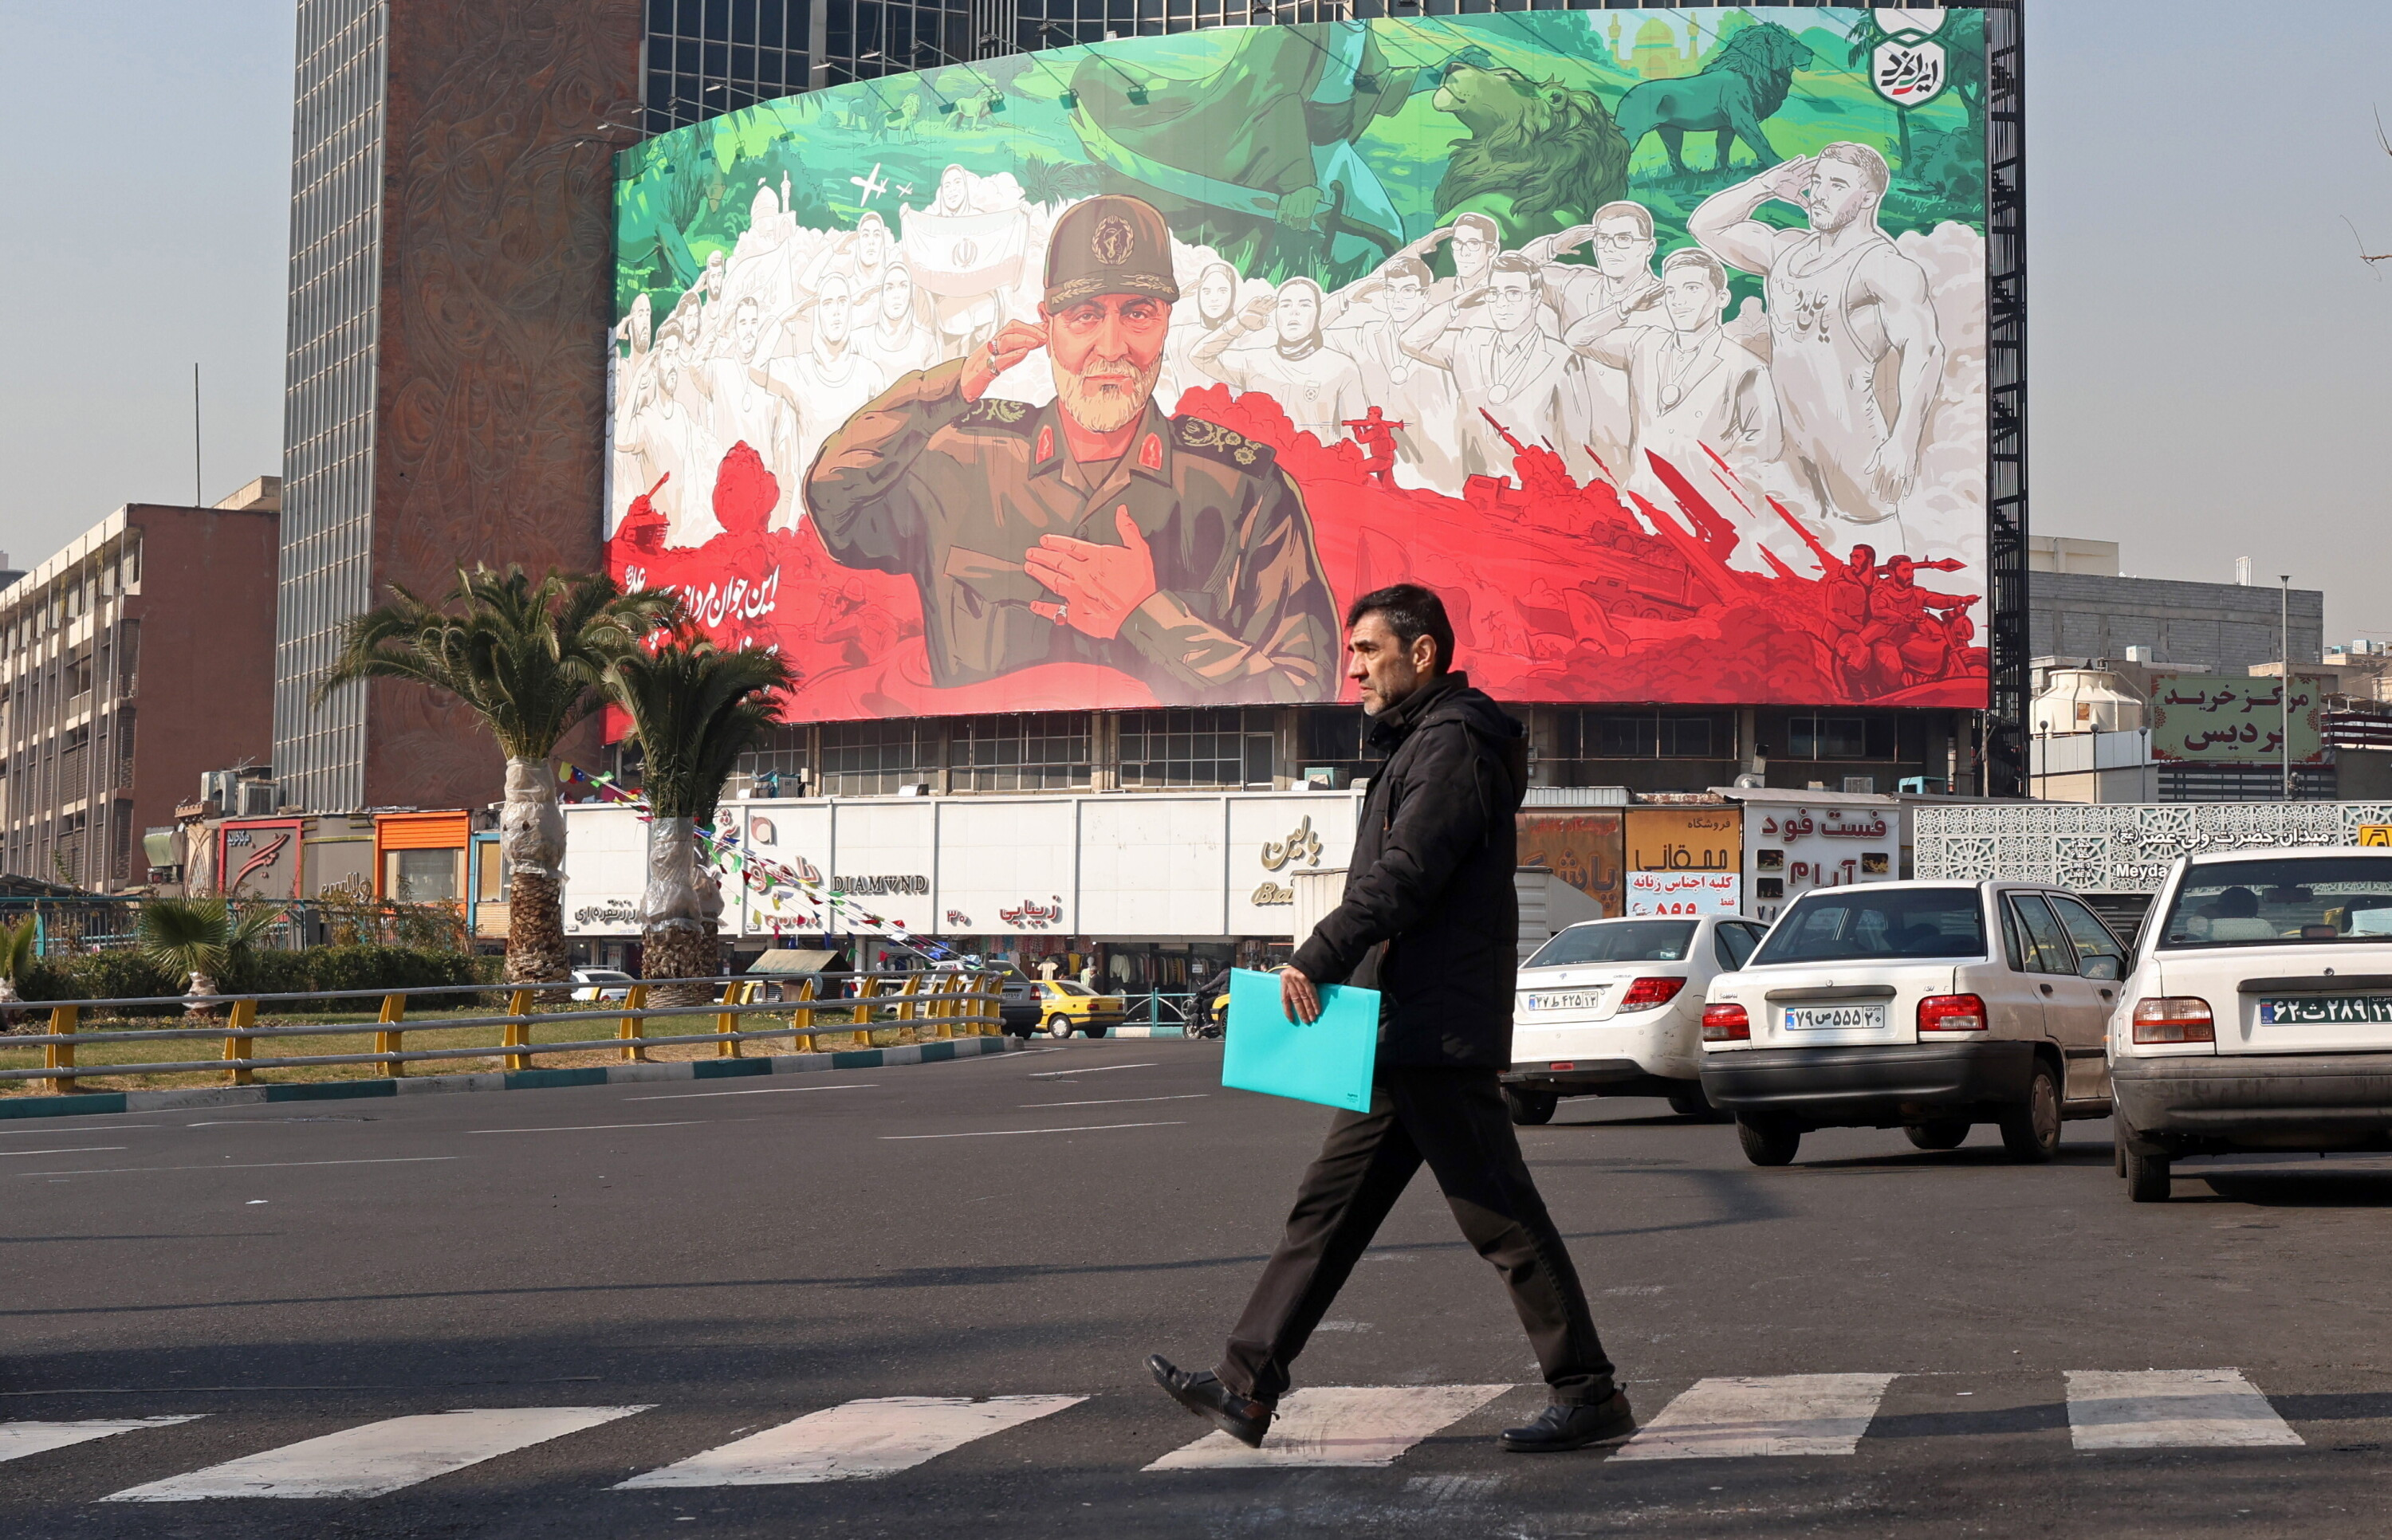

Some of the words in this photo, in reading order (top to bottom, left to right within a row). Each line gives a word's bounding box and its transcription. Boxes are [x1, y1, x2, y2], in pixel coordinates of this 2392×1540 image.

[745, 564, 780, 619] این
[2164, 684, 2237, 713] خرید
[2241, 683, 2309, 713] مرکز
[1687, 818, 1731, 831] فروشگاه
[1760, 807, 1815, 843] فود
[1820, 808, 1888, 838] فست
[1261, 814, 1320, 870] بالین
[2138, 831, 2177, 848] عصر
[2181, 827, 2210, 849] ولی
[2214, 827, 2274, 847] حضرت
[2280, 827, 2329, 847] میدان
[1633, 874, 1662, 892] زنانه
[1665, 874, 1705, 892] اجناس
[1788, 859, 1858, 887] آرام
[2116, 863, 2168, 881] Meyda
[1251, 882, 1293, 905] Ba
[1709, 875, 1733, 892] کلیه
[999, 895, 1058, 925] زیبایی
